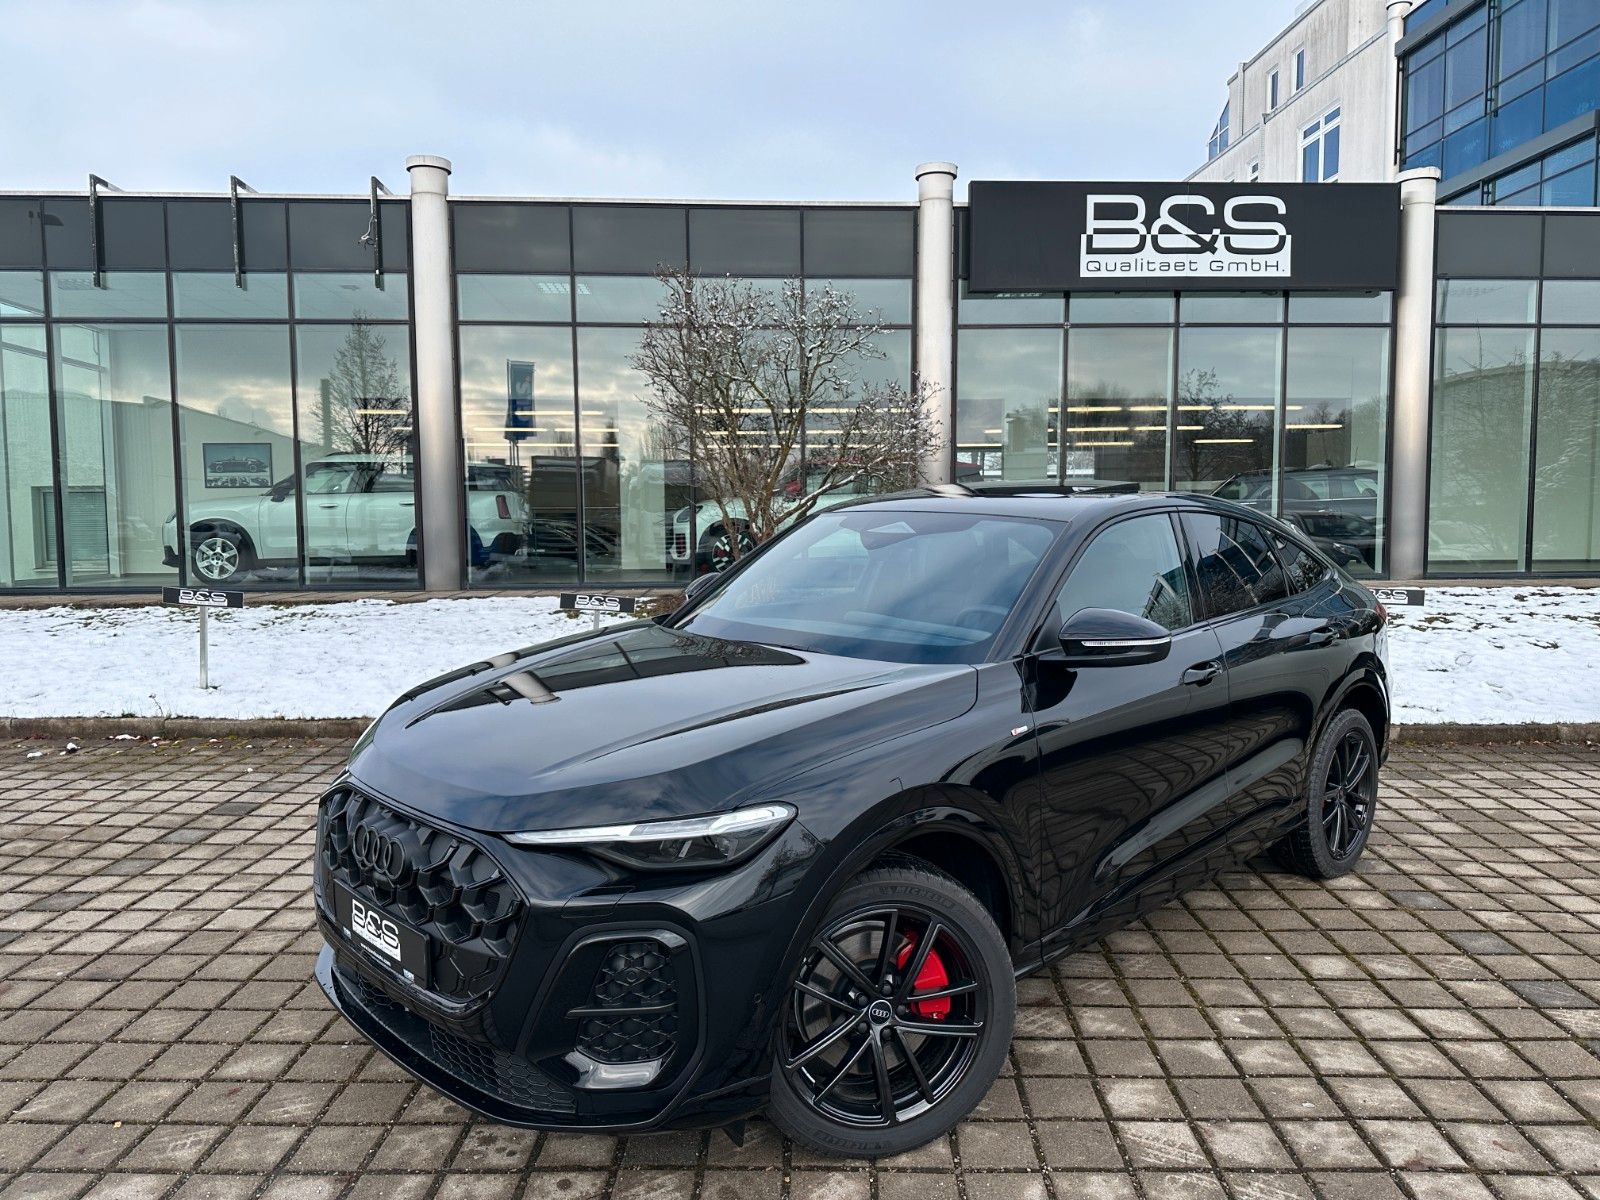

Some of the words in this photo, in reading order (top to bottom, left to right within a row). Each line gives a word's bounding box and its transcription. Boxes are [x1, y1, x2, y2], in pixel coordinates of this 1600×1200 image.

[1086, 194, 1287, 255] B&S
[1086, 258, 1198, 272] Qualitaet
[1209, 258, 1285, 272] GmbH.
[179, 589, 227, 603] B&S
[575, 594, 620, 608] B&S
[352, 898, 400, 950] B&S
